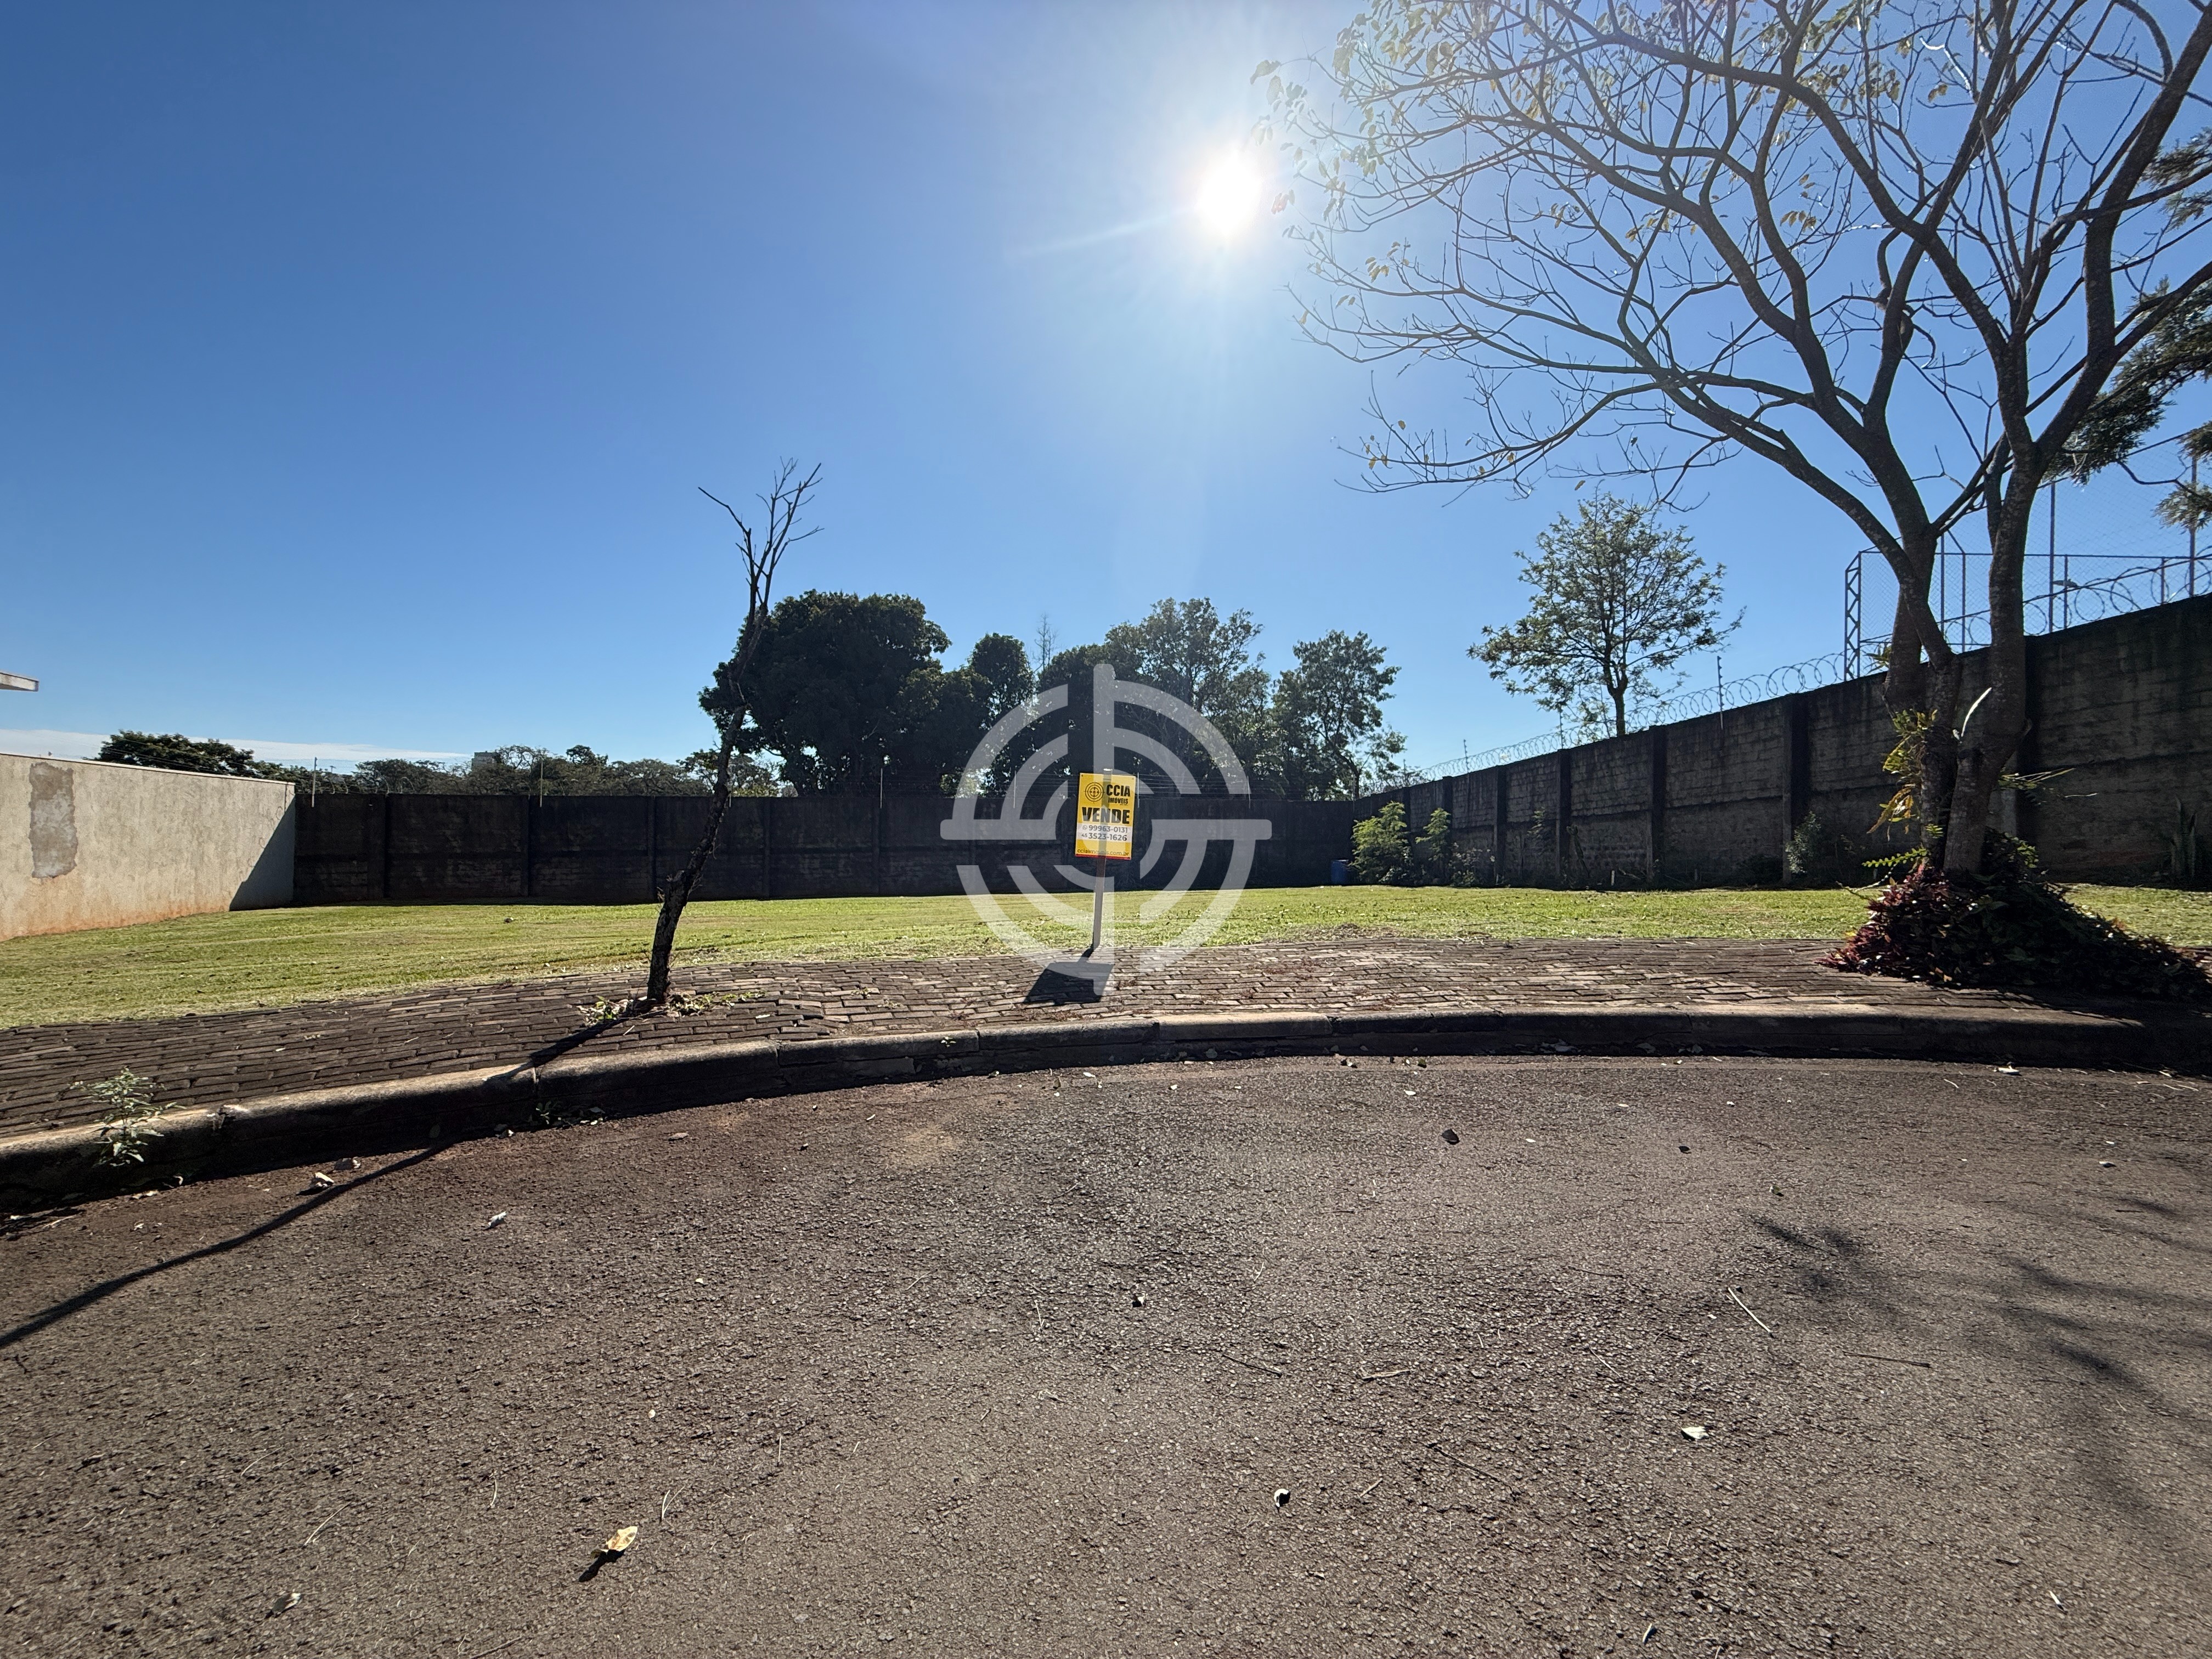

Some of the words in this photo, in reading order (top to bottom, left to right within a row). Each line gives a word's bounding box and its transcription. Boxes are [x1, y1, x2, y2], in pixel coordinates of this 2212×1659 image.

[1107, 785, 1131, 797] CCIA
[1082, 807, 1130, 824] VENDE
[1088, 833, 1127, 841] 3523-1626
